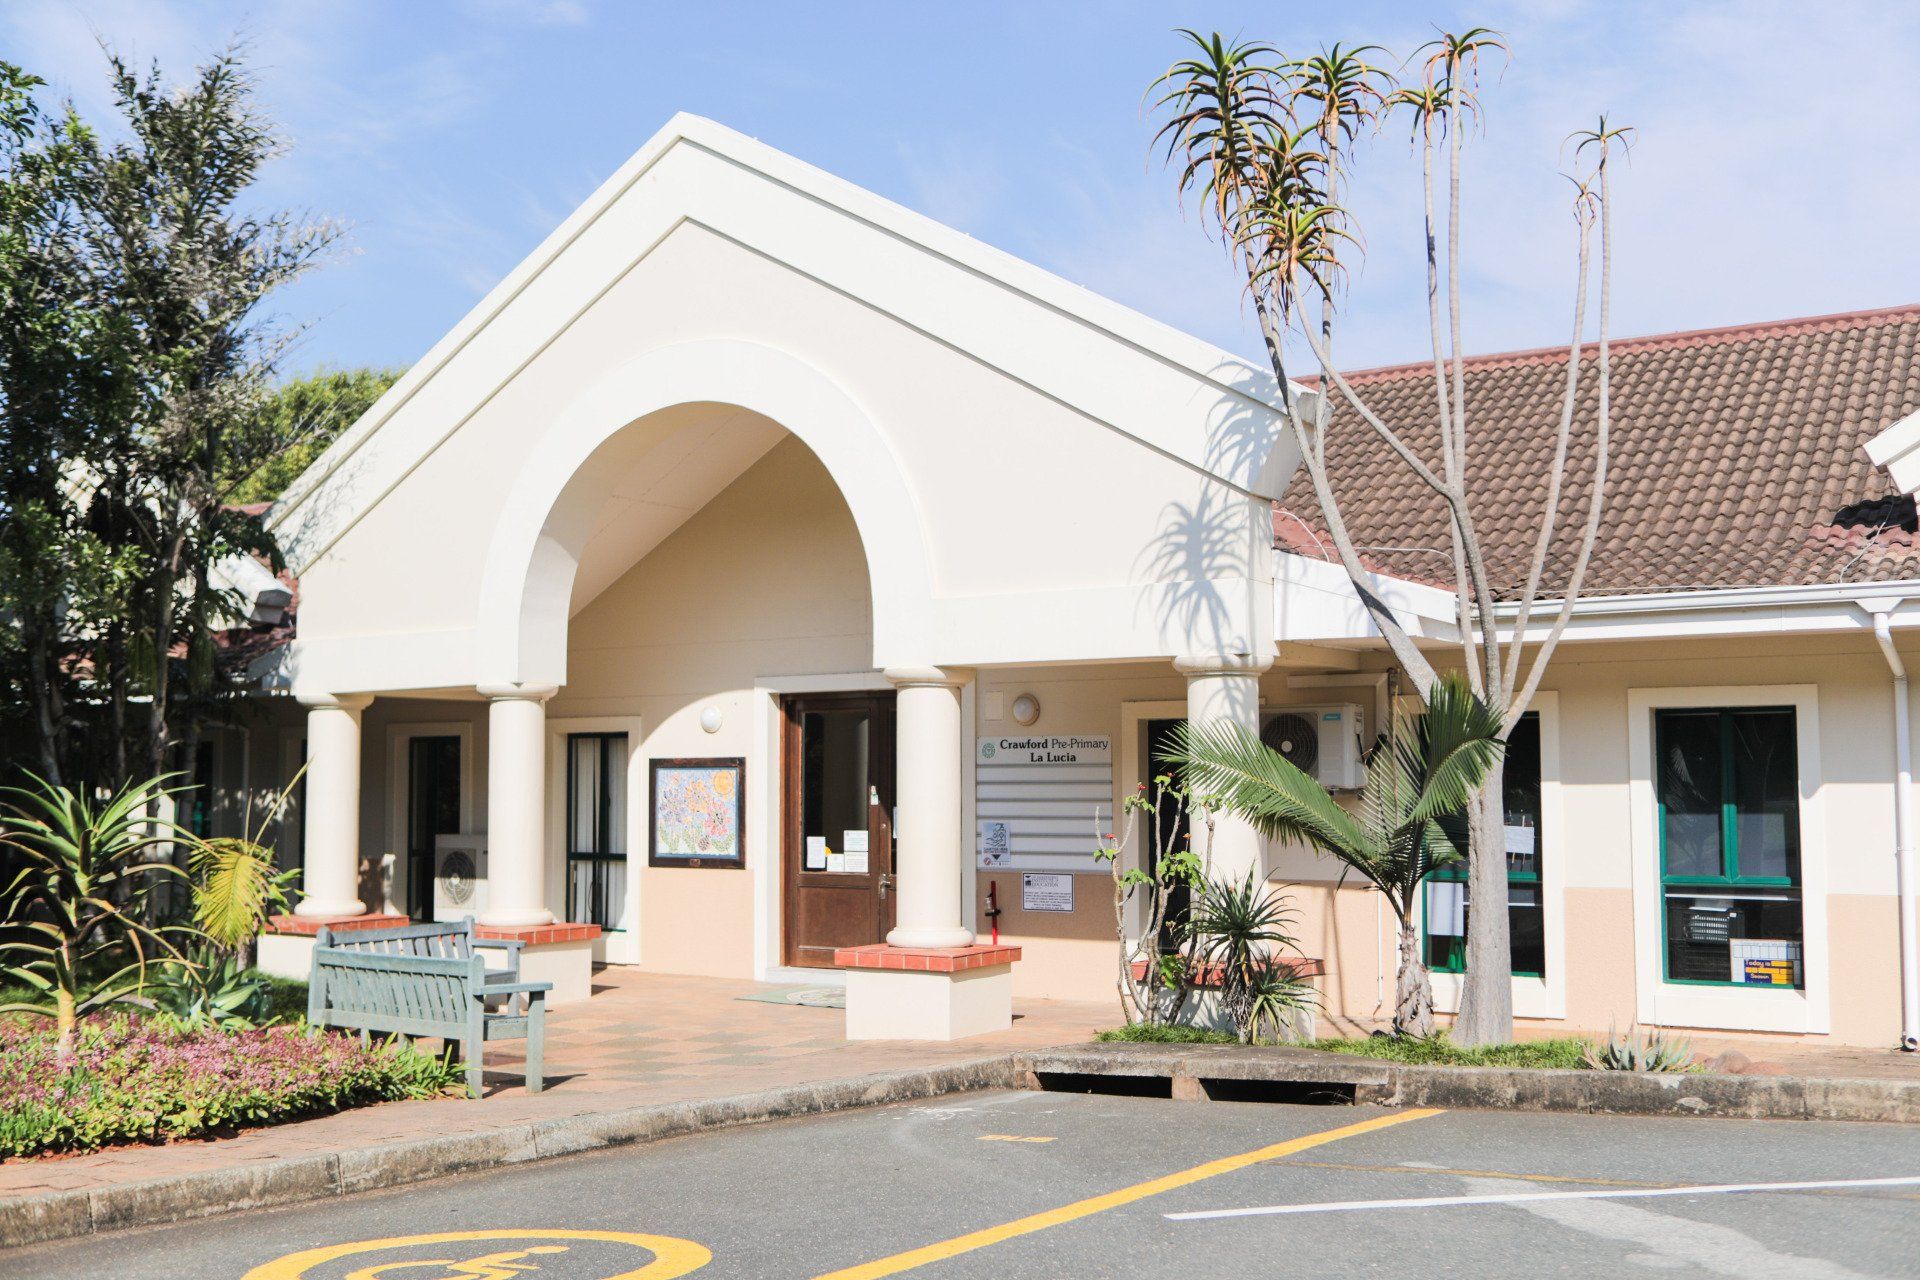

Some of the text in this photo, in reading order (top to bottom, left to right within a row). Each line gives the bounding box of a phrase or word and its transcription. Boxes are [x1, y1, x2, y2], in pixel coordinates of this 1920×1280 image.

[1000, 739, 1109, 750] Crawford Pre-Primary
[1030, 752, 1077, 762] La Lucia
[1745, 960, 1764, 968] Today
